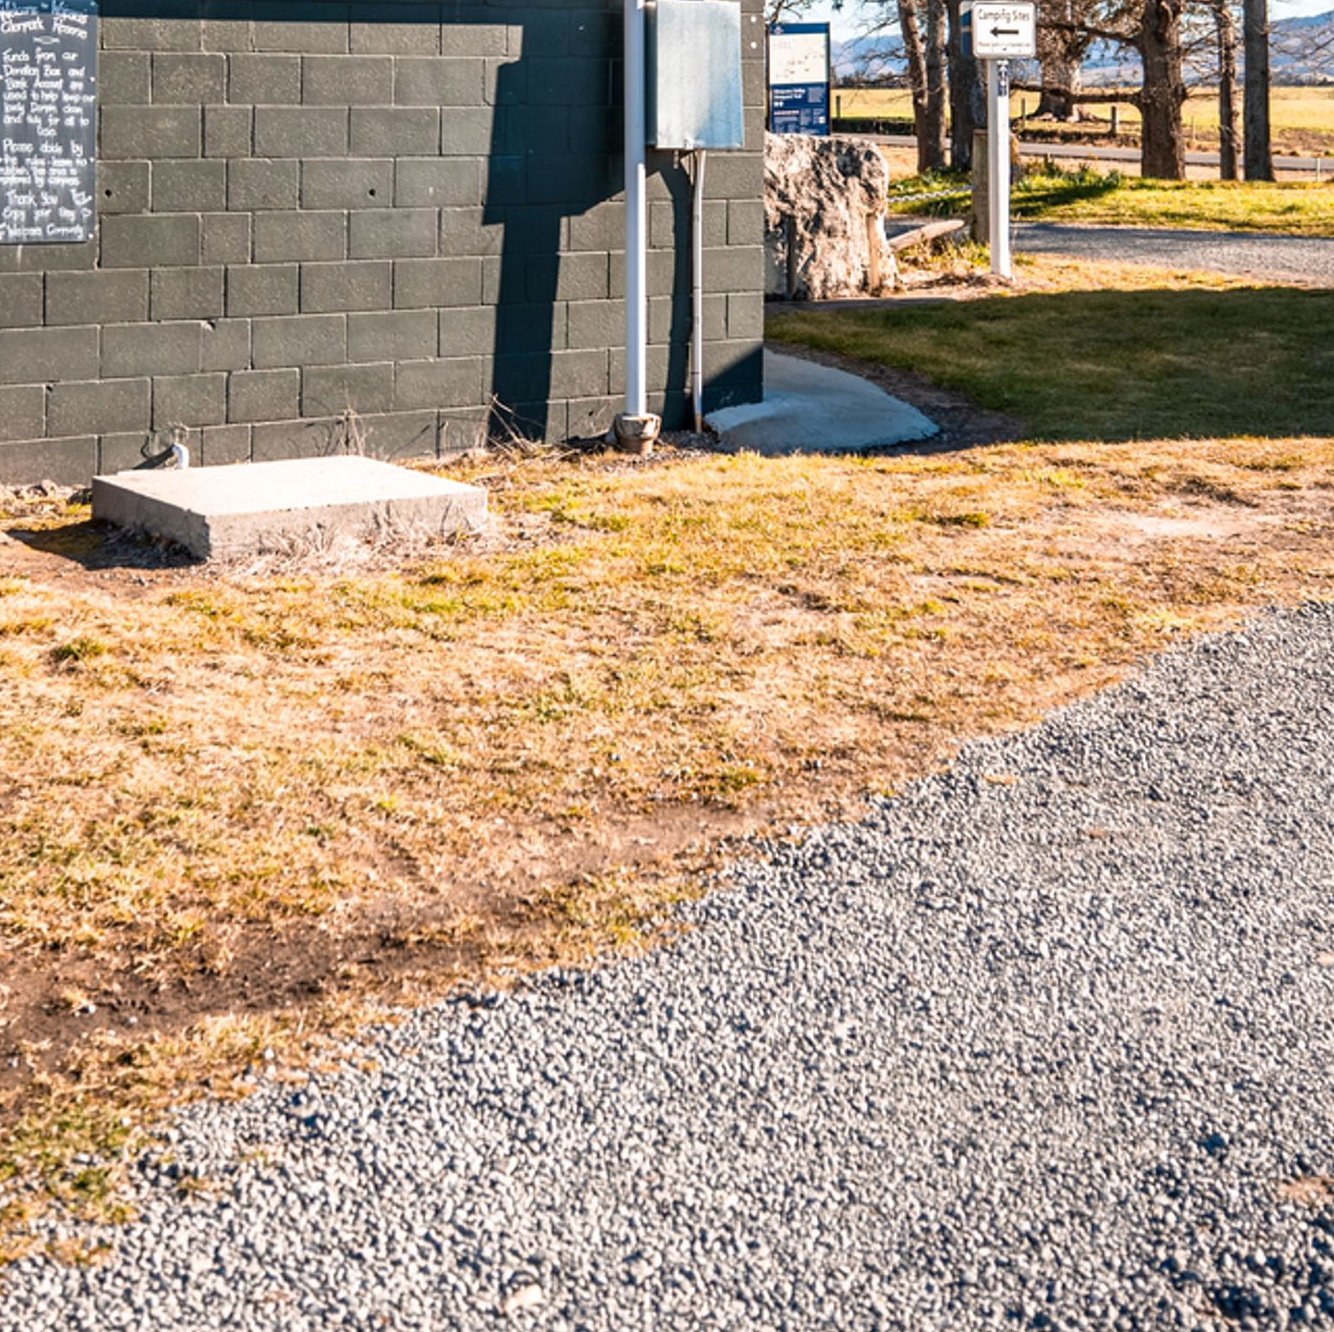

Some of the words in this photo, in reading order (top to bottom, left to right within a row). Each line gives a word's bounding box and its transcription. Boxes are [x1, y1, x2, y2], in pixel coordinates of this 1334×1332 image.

[978, 8, 1011, 23] Camping
[1012, 10, 1030, 22] Sites
[2, 48, 30, 62] Funds
[35, 47, 56, 64] from
[61, 52, 79, 61] our
[3, 64, 39, 77] Donation
[43, 64, 61, 77] Box
[68, 66, 86, 77] and
[3, 90, 27, 101] used
[30, 90, 39, 101] to
[41, 90, 58, 102] help
[3, 113, 22, 124] and
[48, 114, 60, 127] for
[64, 116, 75, 127] all
[79, 116, 90, 127] to
[3, 138, 34, 154] Please
[69, 140, 83, 157] by
[5, 189, 38, 206] Thank
[40, 191, 58, 206] You
